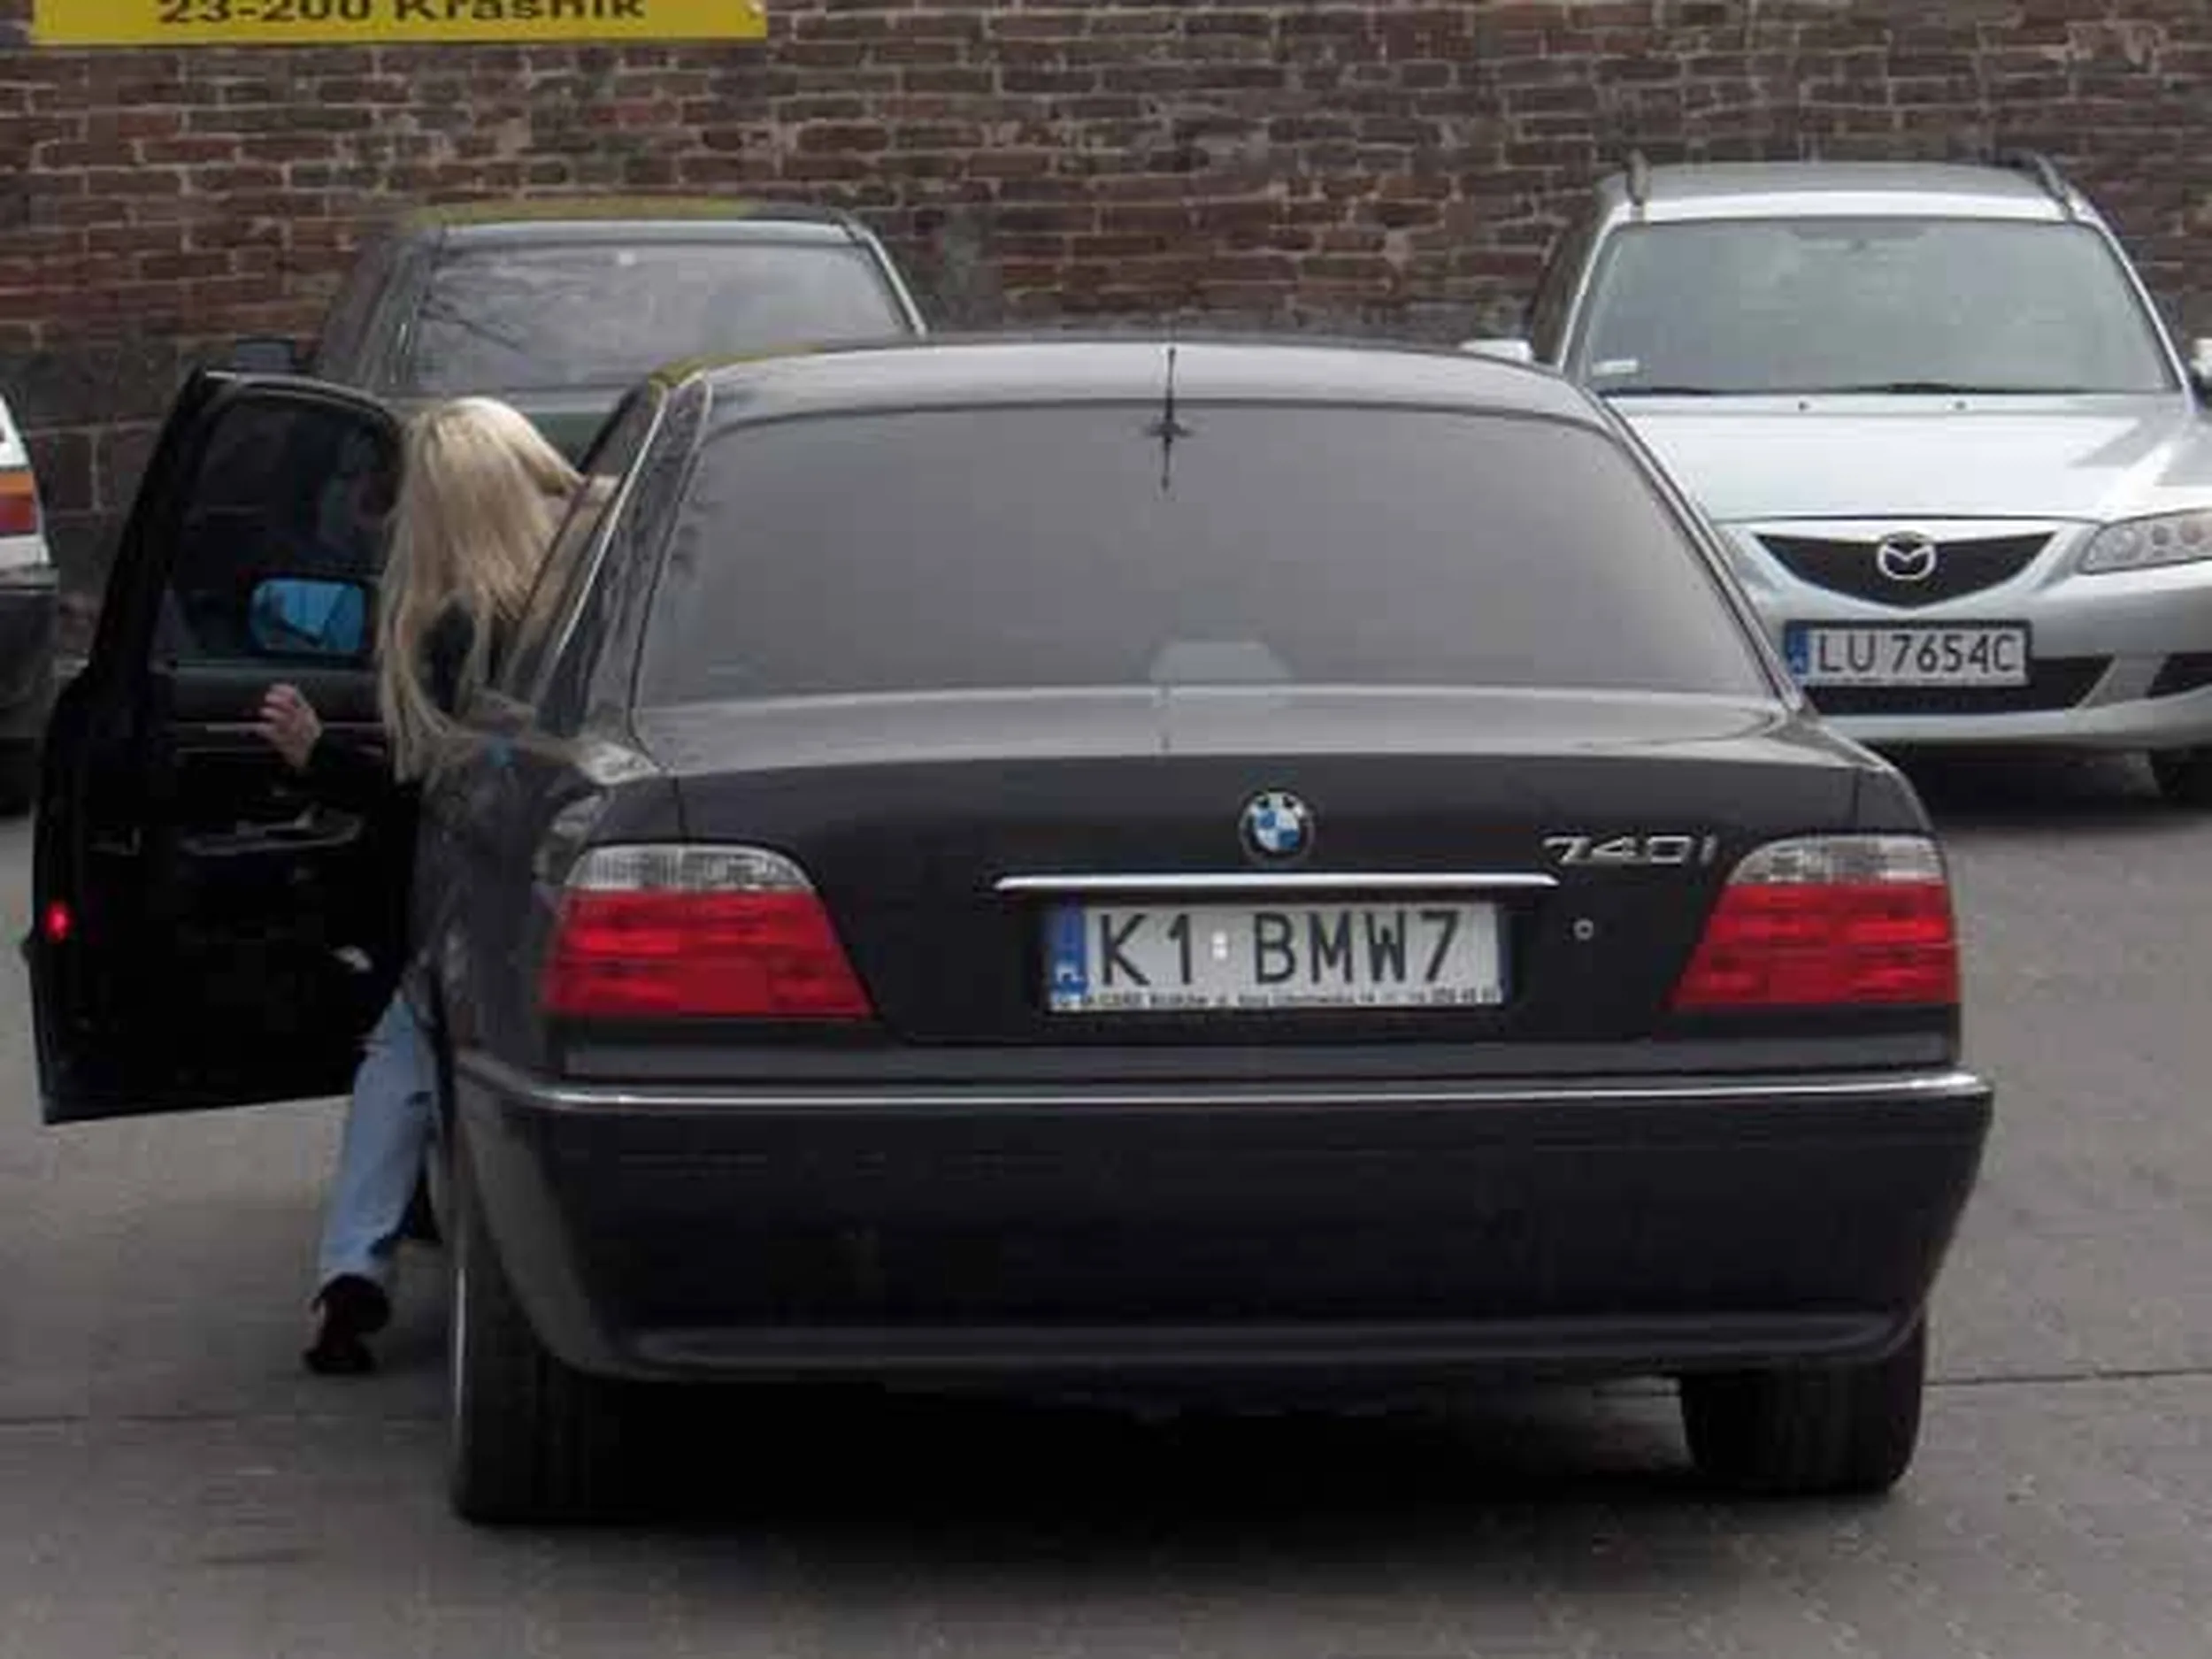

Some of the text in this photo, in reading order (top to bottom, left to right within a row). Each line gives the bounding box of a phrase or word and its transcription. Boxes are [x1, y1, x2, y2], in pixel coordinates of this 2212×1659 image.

[157, 0, 373, 22] 23-200
[1819, 634, 1877, 672] LU
[1891, 634, 2016, 673] 7654C
[1543, 834, 1719, 865] 740i
[1100, 910, 1461, 986] K1 BMW7
